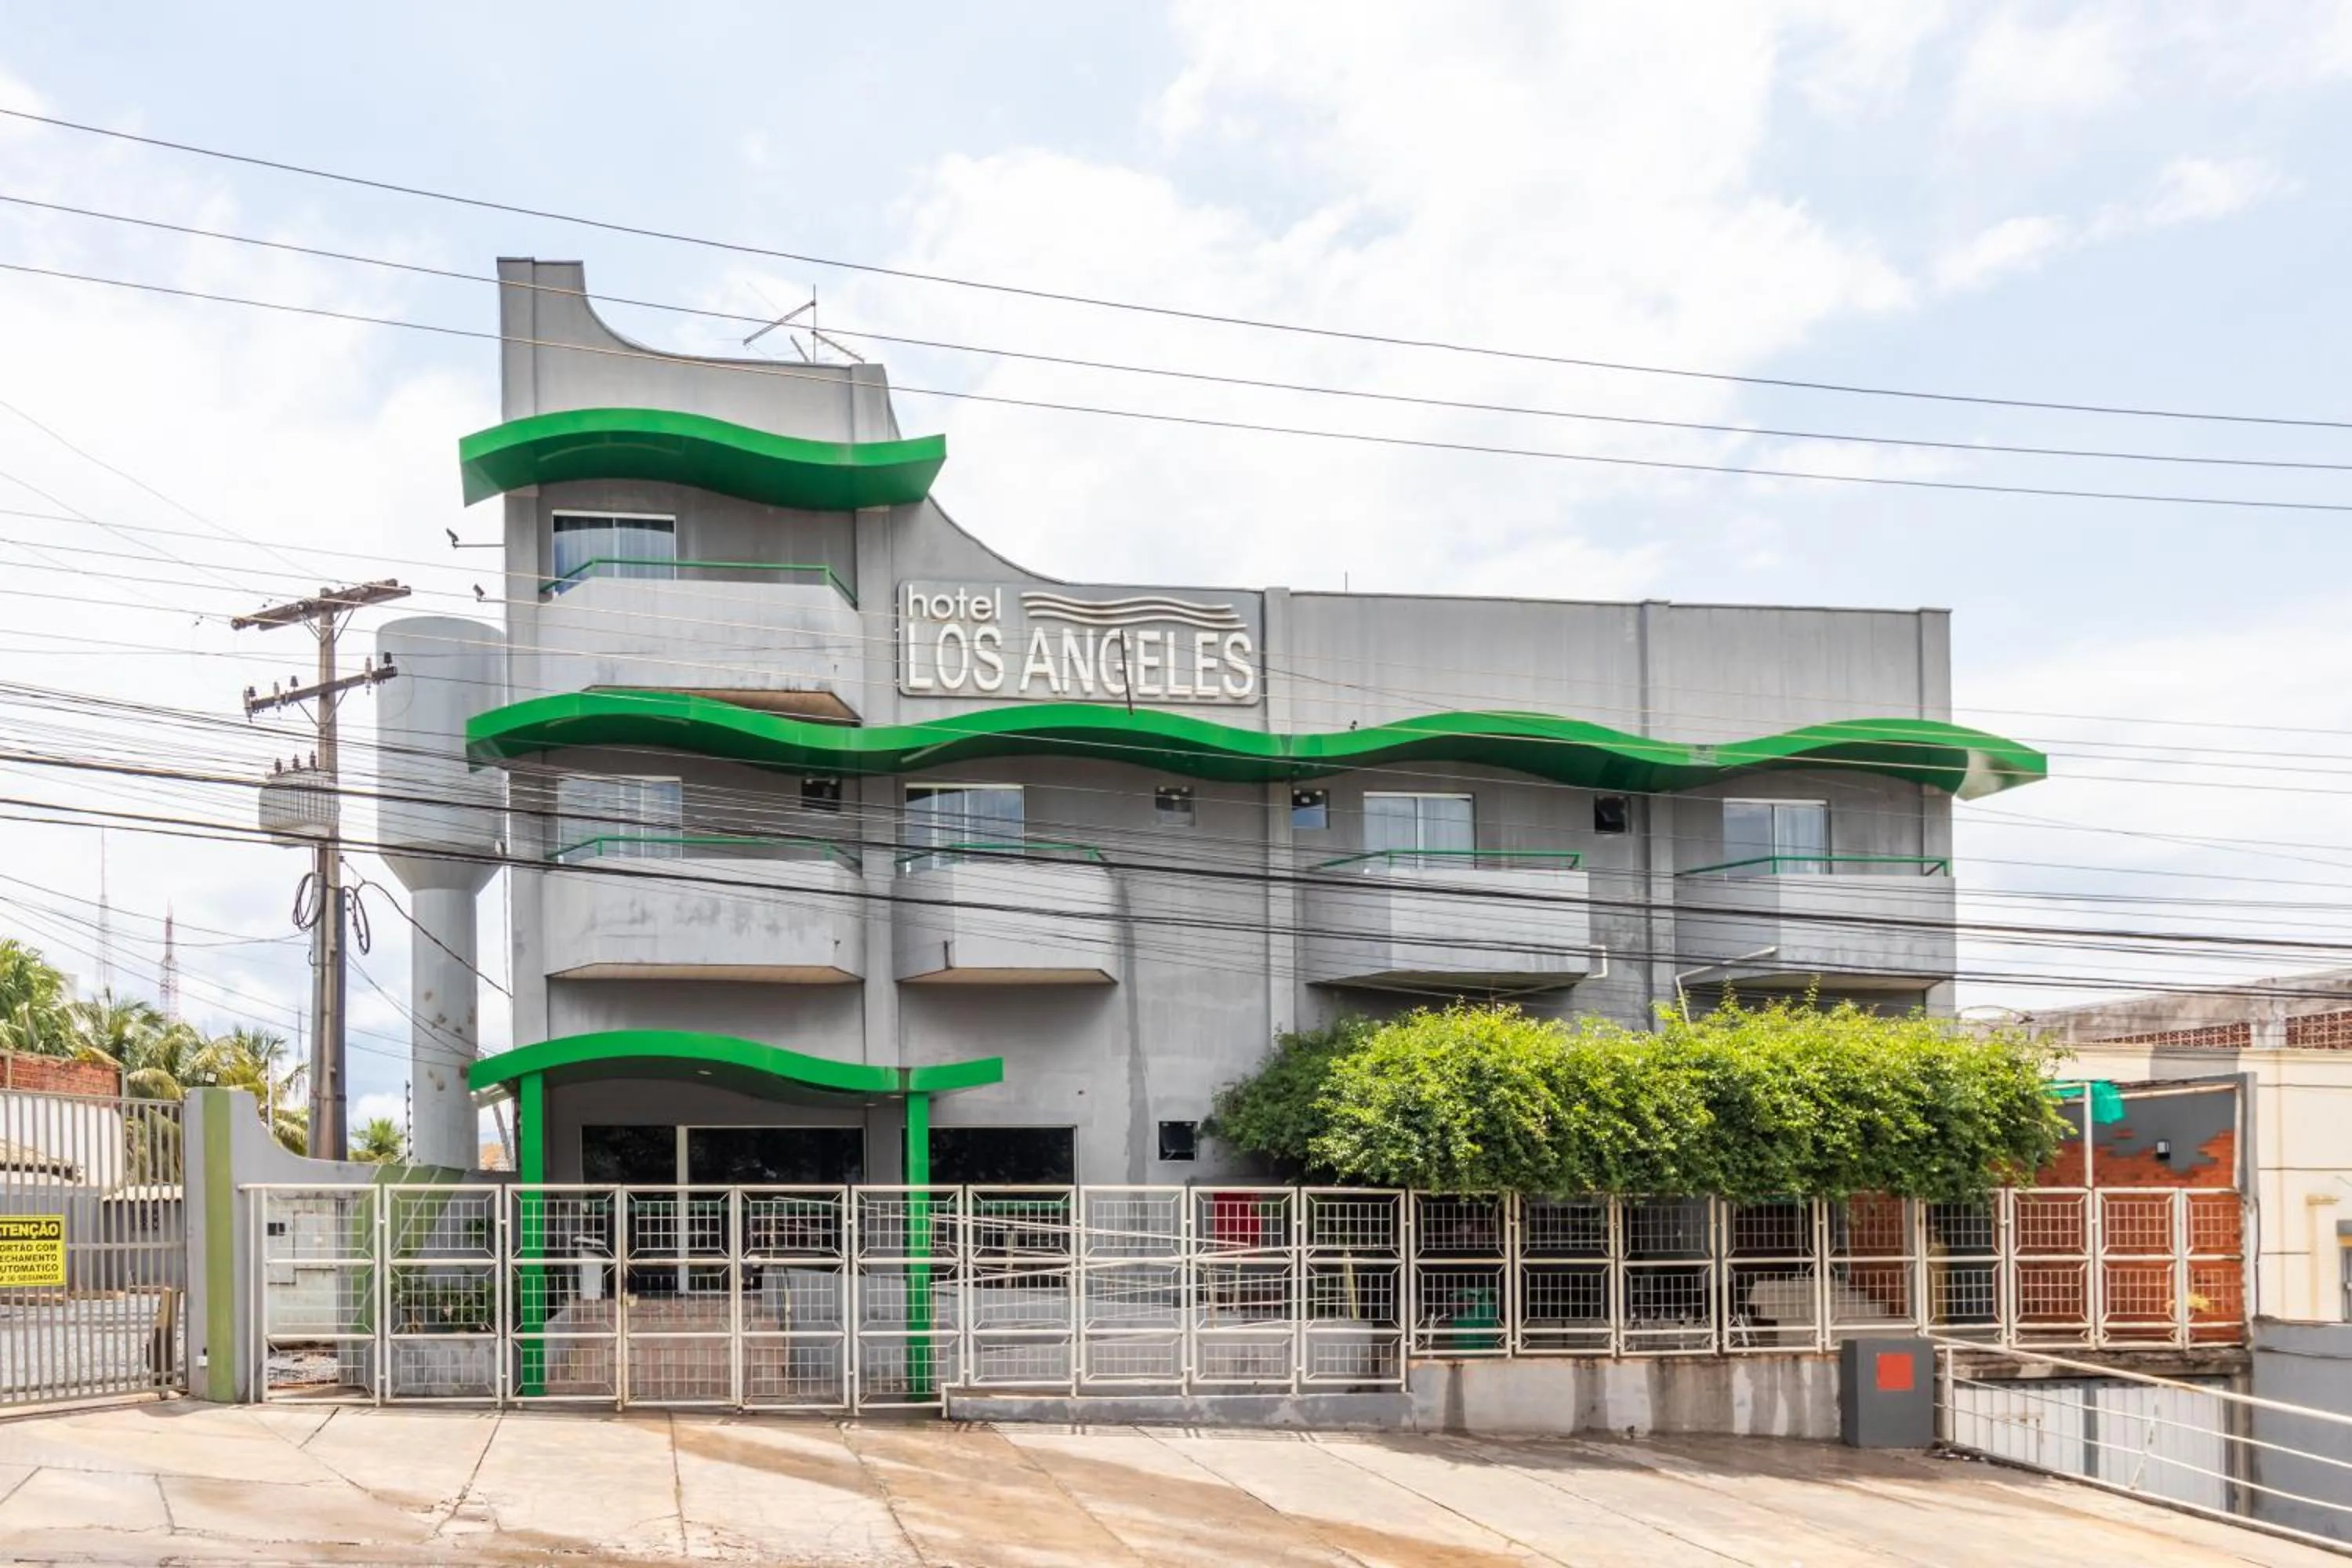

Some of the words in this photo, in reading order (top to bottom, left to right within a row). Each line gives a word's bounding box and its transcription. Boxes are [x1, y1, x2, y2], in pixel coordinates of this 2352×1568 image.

[908, 584, 1001, 620] hotel
[908, 622, 1004, 691] LOS
[1019, 627, 1254, 699] ANGELES
[0, 1220, 60, 1239] TENÇÃO
[0, 1243, 33, 1252] ORTÃO
[35, 1243, 57, 1252] COM
[0, 1254, 57, 1262] ECHAMENTO
